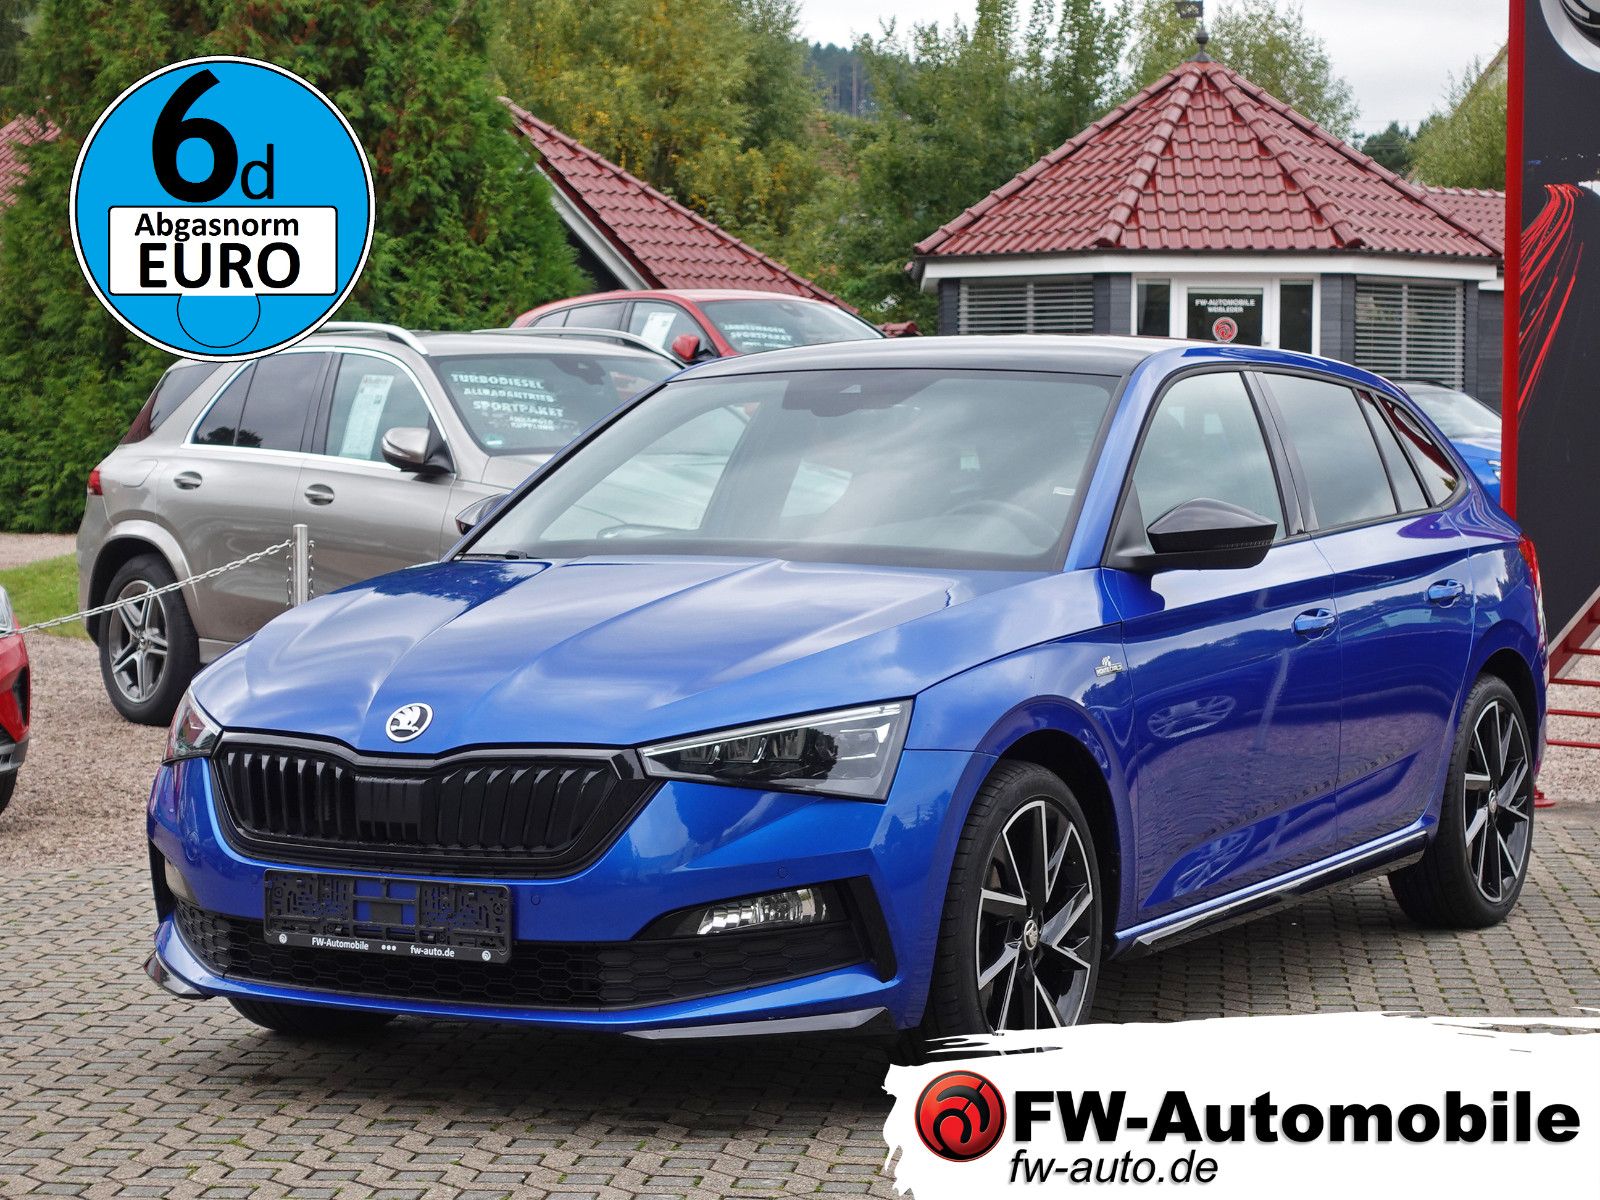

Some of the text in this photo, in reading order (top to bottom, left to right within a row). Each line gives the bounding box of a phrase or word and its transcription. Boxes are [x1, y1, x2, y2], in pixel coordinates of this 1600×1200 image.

[1195, 298, 1256, 307] FW-AUTOMOBILE
[450, 373, 545, 390] TURBODIESEL
[472, 400, 565, 418] SPORTPAKET
[311, 936, 455, 958] FW-Automobile fw-auto.de
